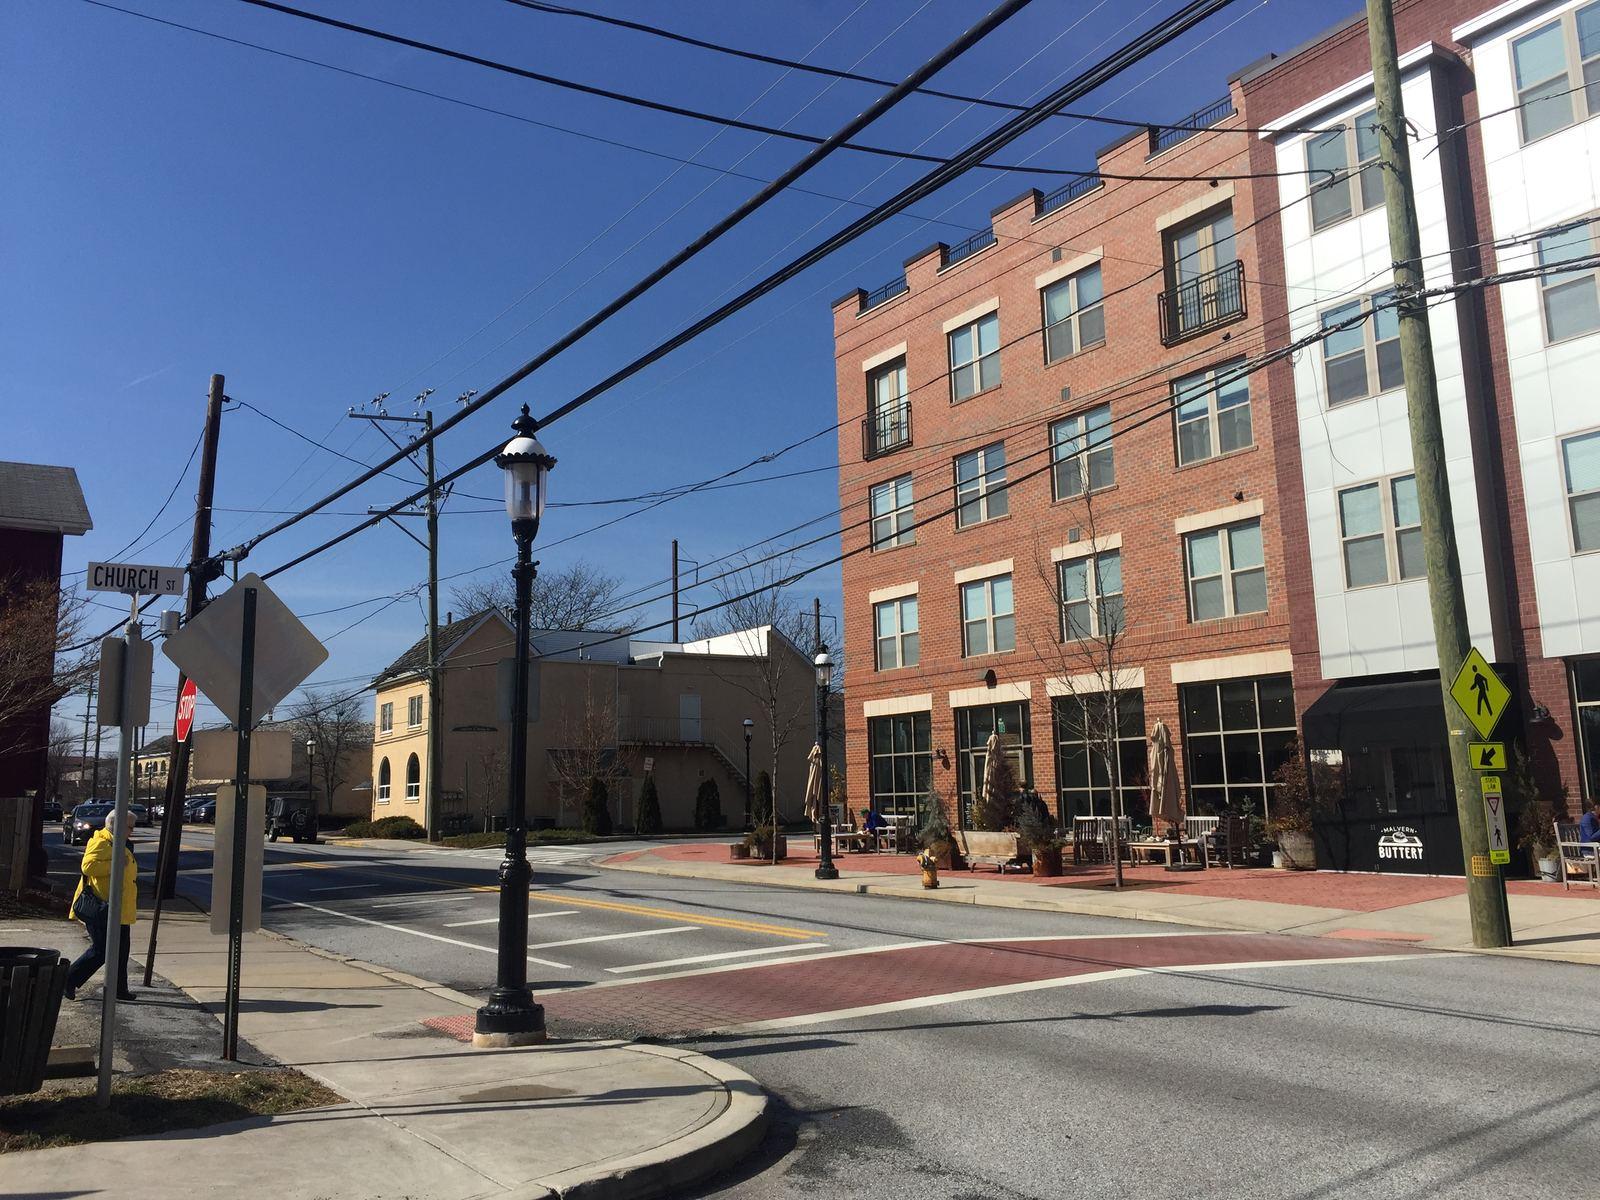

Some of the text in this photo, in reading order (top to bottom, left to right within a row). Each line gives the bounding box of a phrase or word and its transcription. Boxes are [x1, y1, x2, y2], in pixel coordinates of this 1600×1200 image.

[93, 566, 176, 591] CHURCH ST
[178, 694, 195, 720] STOP
[1383, 826, 1415, 834] MALVERN
[1378, 846, 1423, 860] BUTTERY
